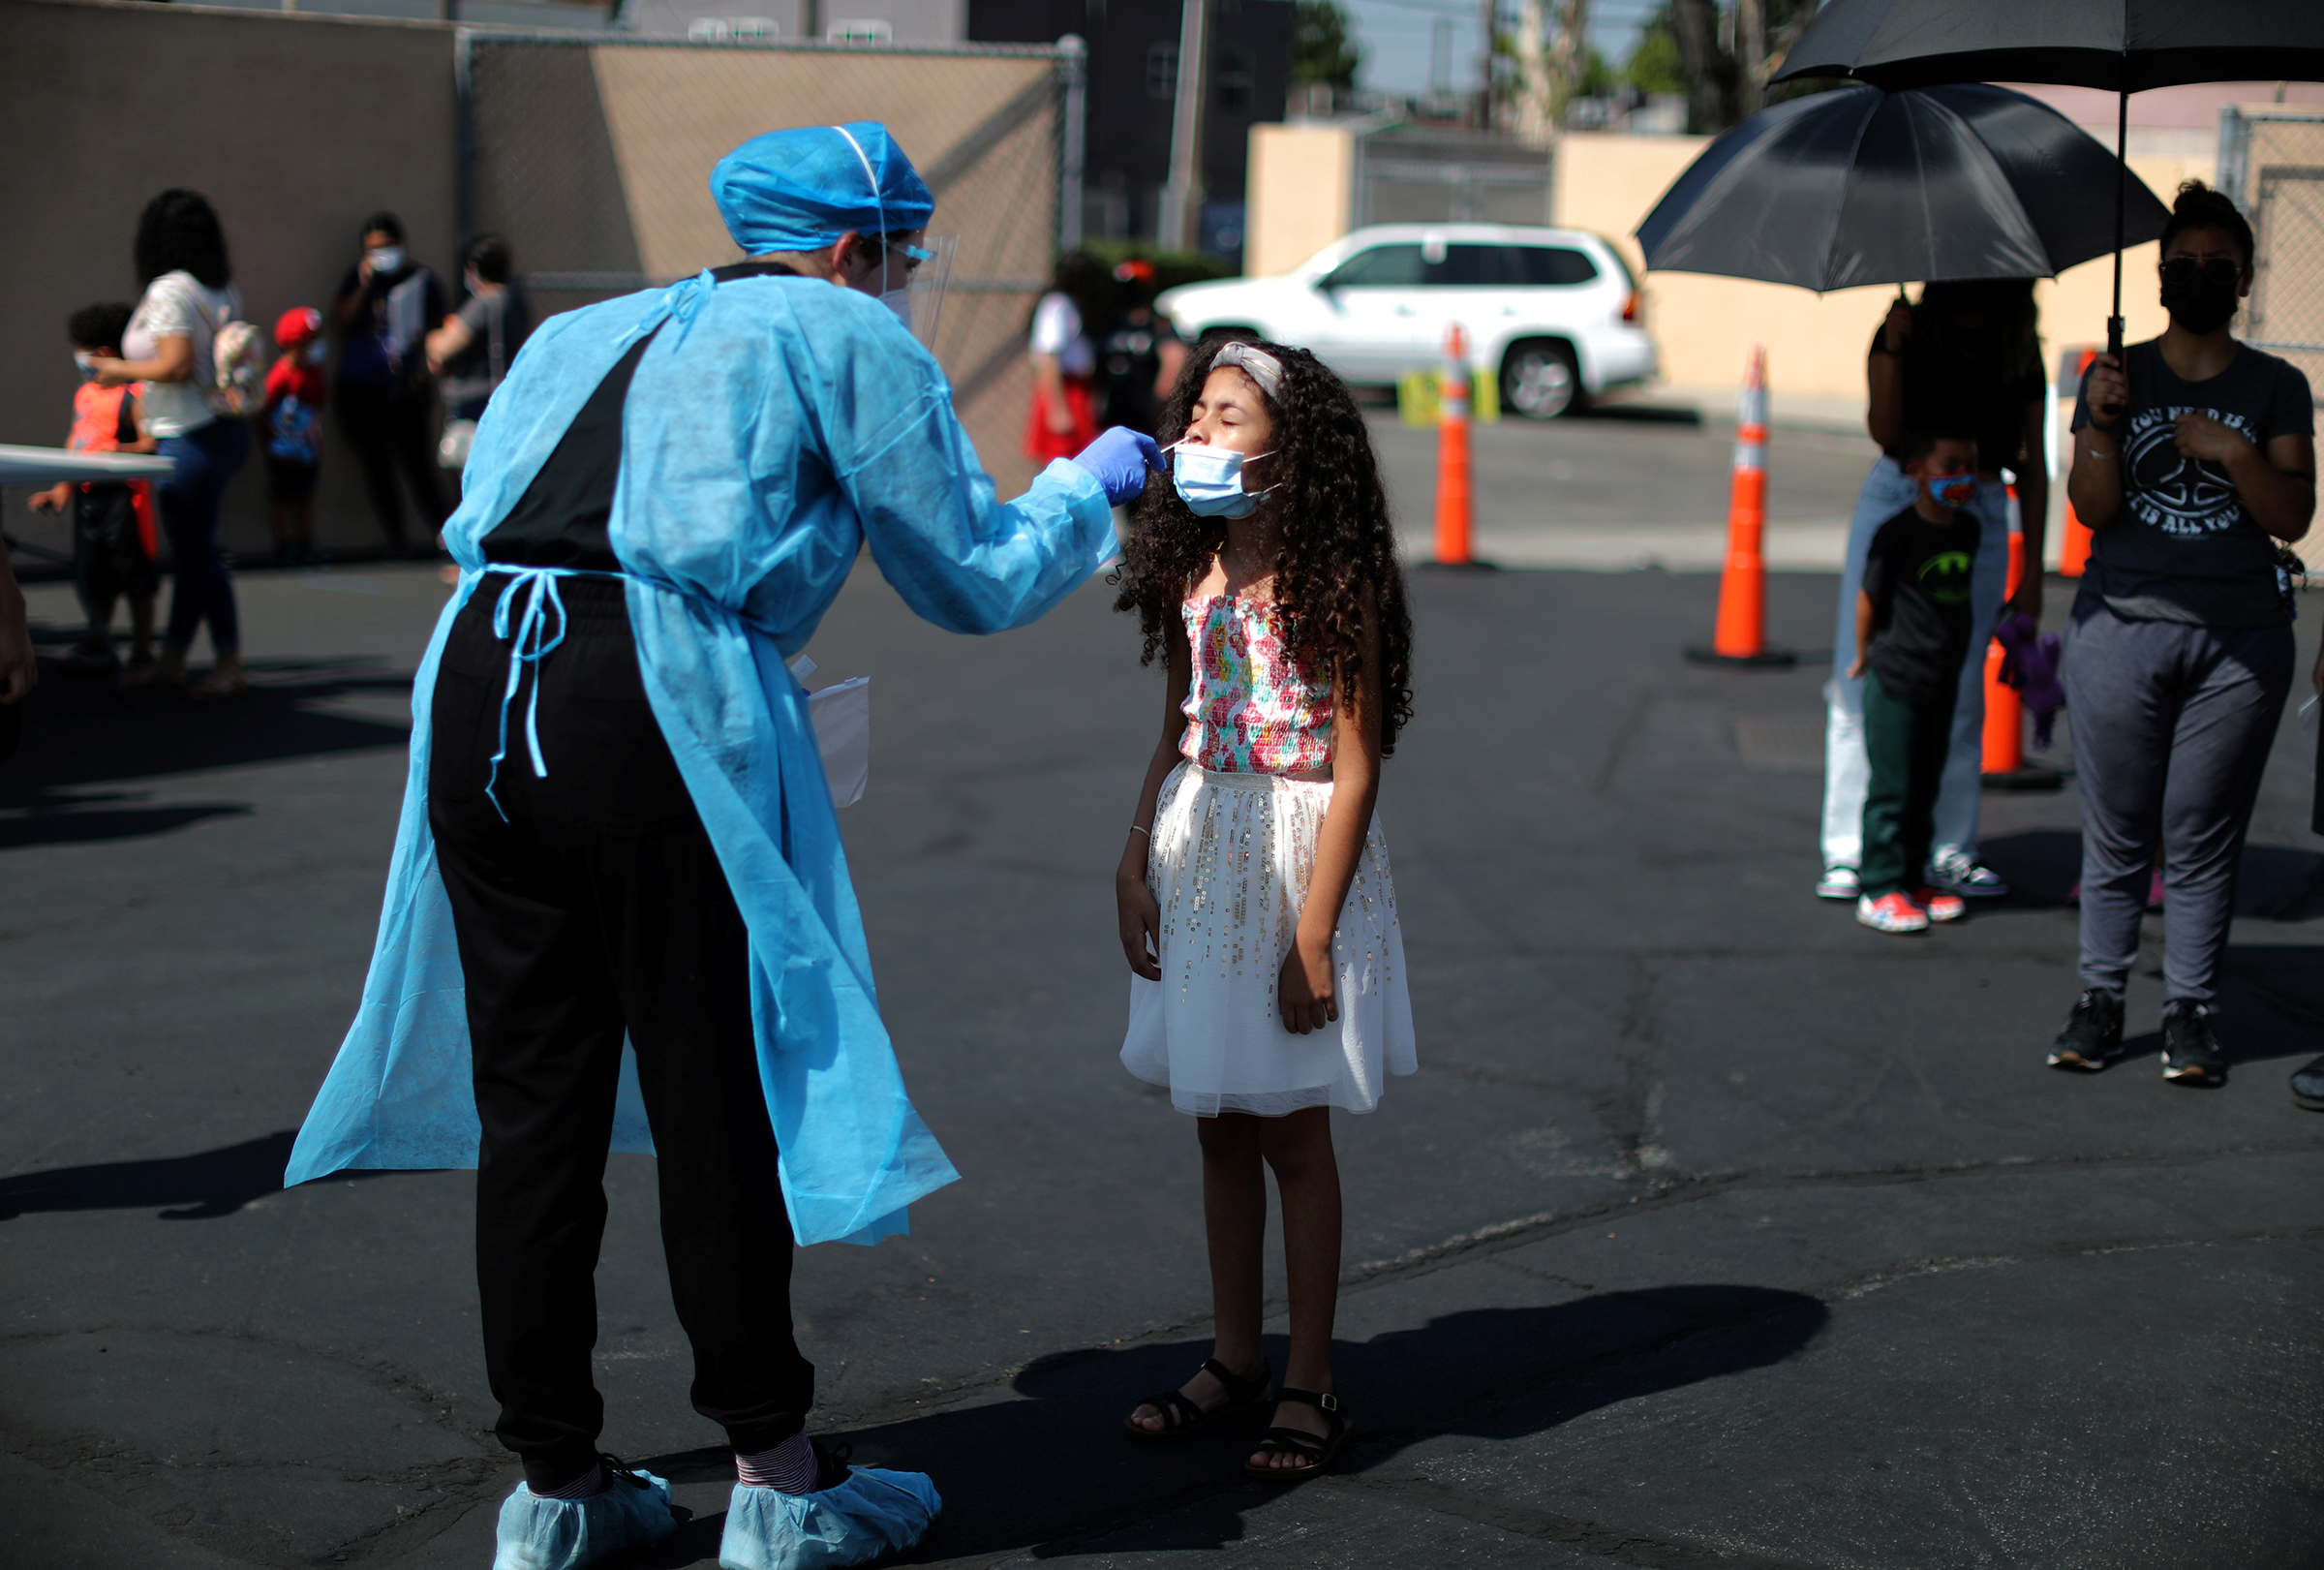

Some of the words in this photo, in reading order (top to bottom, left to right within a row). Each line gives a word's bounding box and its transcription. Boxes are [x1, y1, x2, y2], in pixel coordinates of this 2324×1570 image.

[2129, 407, 2164, 435] YOU
[2222, 412, 2246, 430] IS
[2138, 503, 2161, 526] IS
[2160, 514, 2203, 535] ALL
[2203, 505, 2242, 532] YOU
